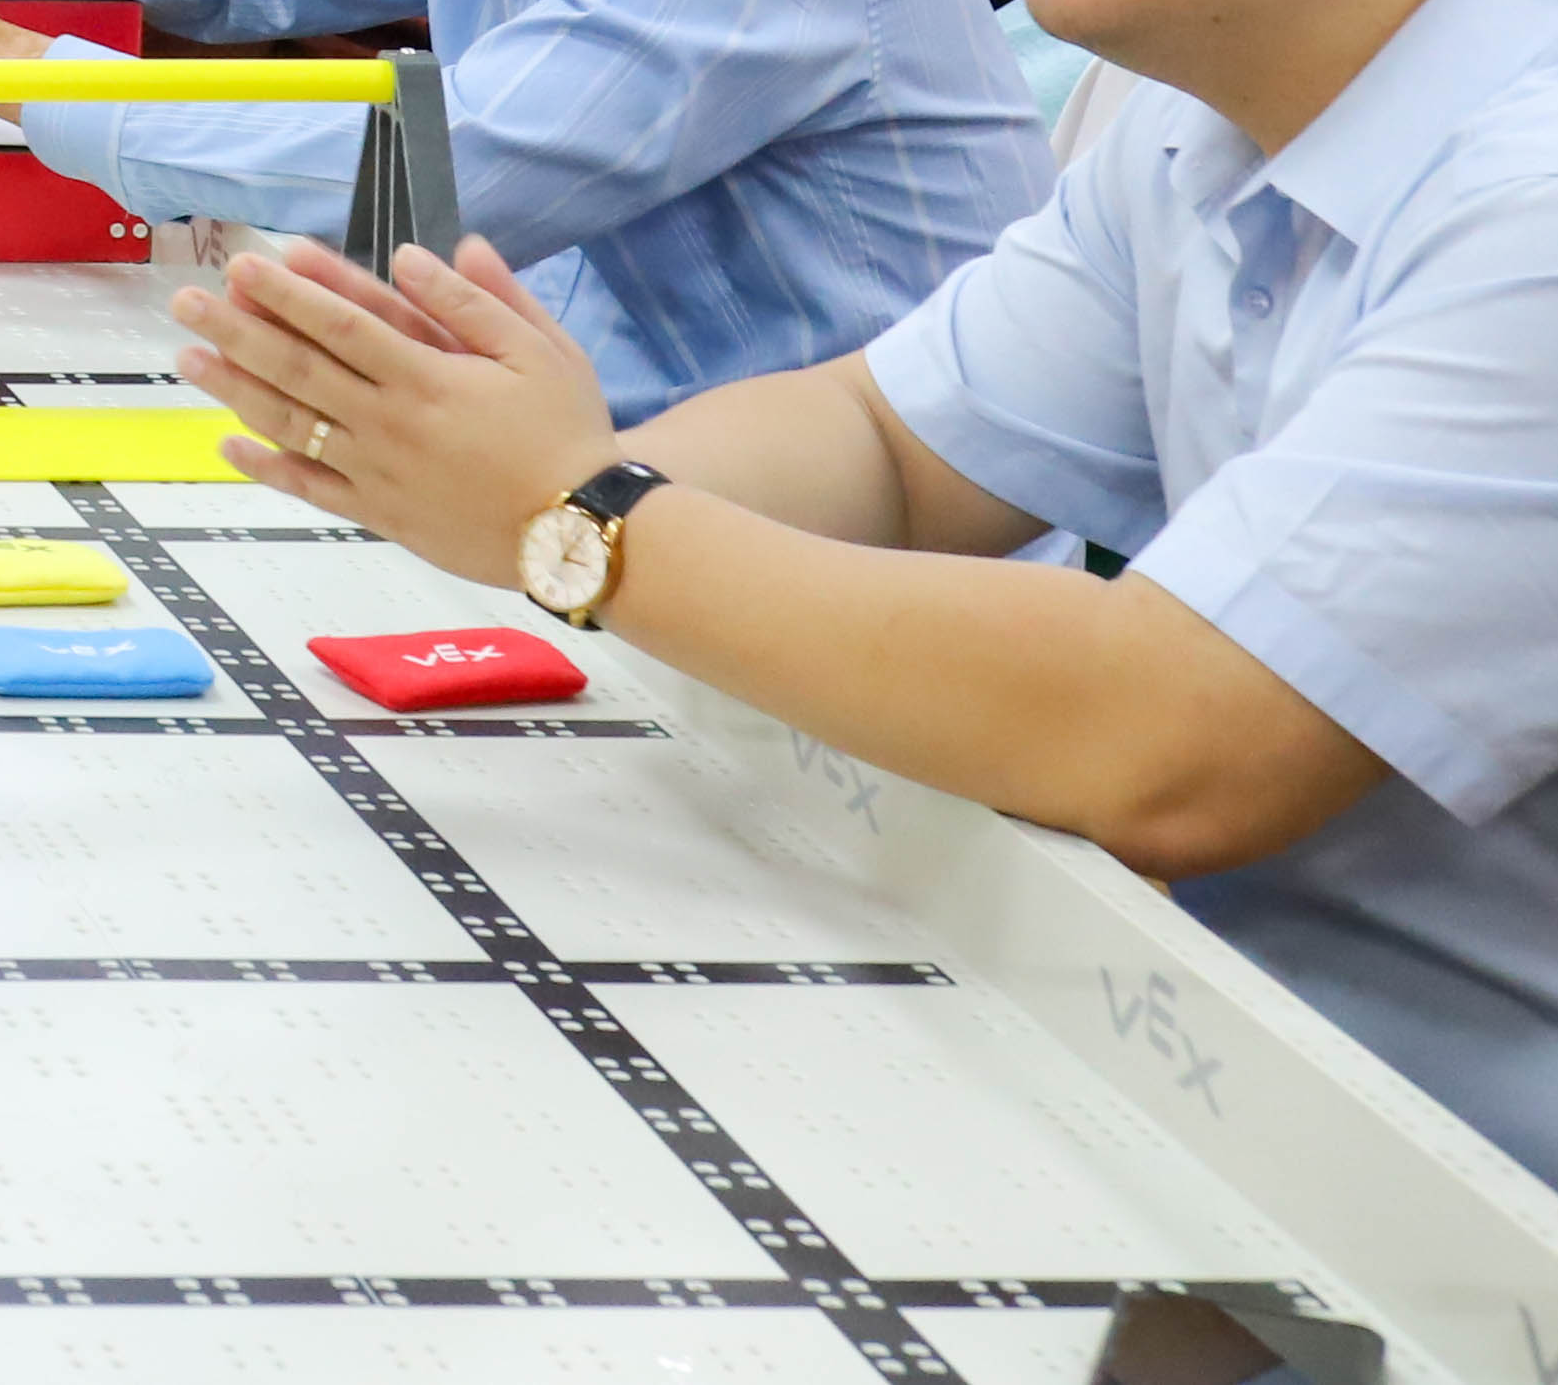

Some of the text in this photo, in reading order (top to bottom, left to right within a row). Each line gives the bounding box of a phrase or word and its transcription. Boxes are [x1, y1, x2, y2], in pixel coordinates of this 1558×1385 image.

[191, 218, 229, 271] VE
[38, 640, 138, 657] VEX
[401, 643, 506, 667] VEX
[1099, 965, 1223, 1120] VEX
